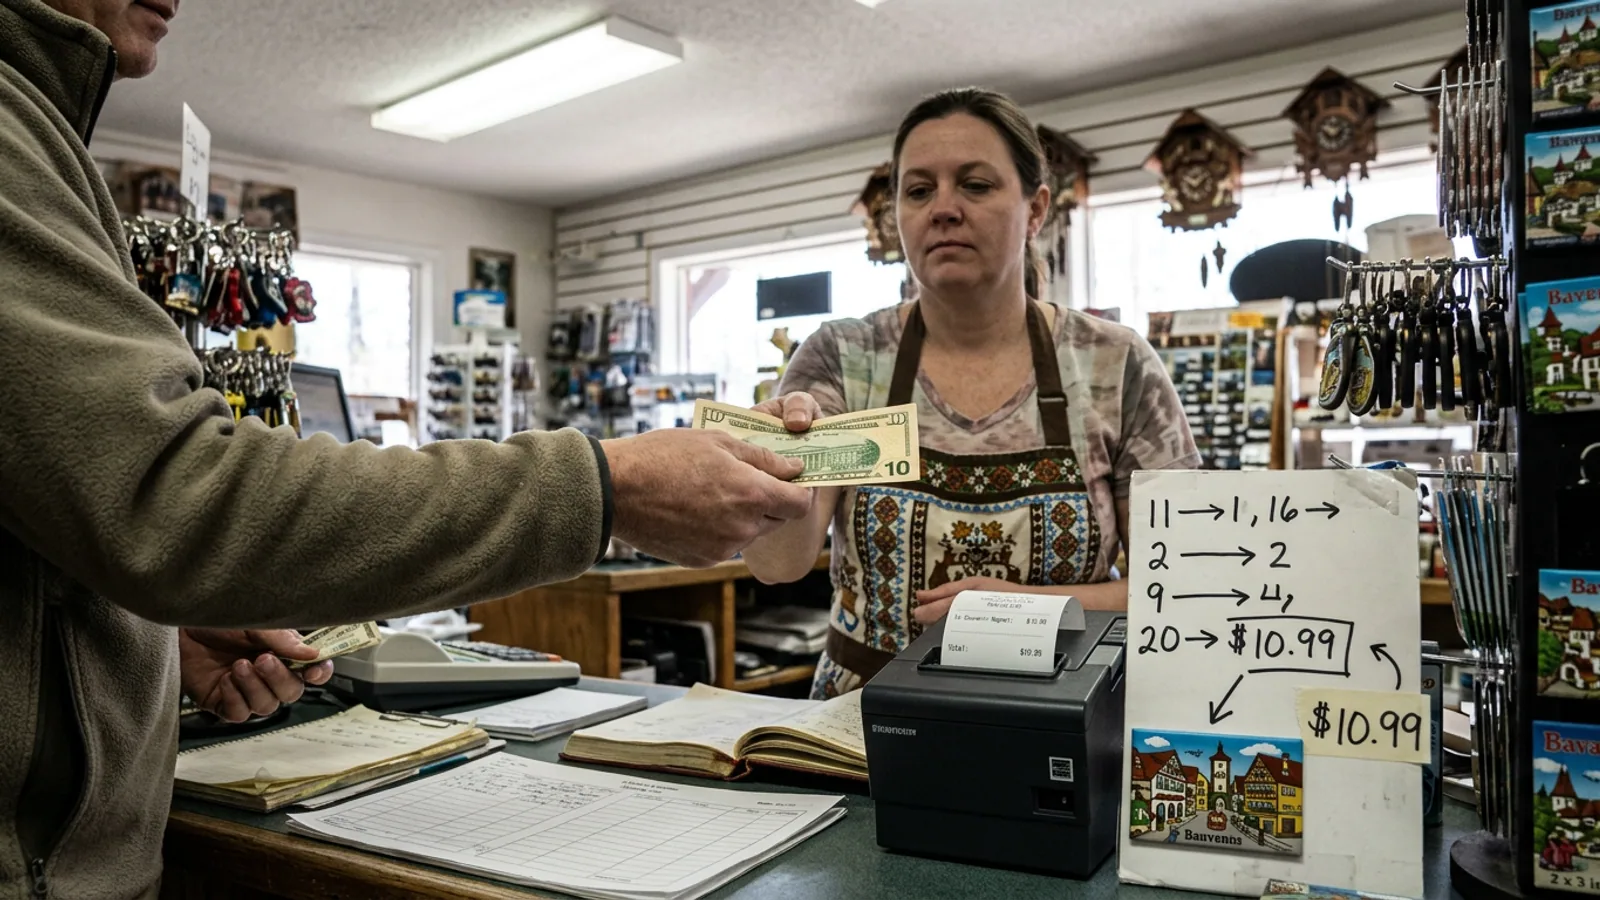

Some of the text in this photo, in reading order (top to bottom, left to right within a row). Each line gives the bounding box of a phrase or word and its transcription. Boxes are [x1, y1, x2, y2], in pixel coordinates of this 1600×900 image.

[1547, 288, 1600, 305] Bave
[884, 460, 910, 476] 10
[1148, 541, 1292, 571] 2 2
[1146, 582, 1165, 614] 9
[1571, 577, 1600, 595] Ba
[1138, 622, 1335, 660] 20 $10.99
[1307, 700, 1422, 752] $10.99
[1550, 873, 1559, 884] 2
[1563, 877, 1572, 886] x
[1576, 876, 1586, 888] 3
